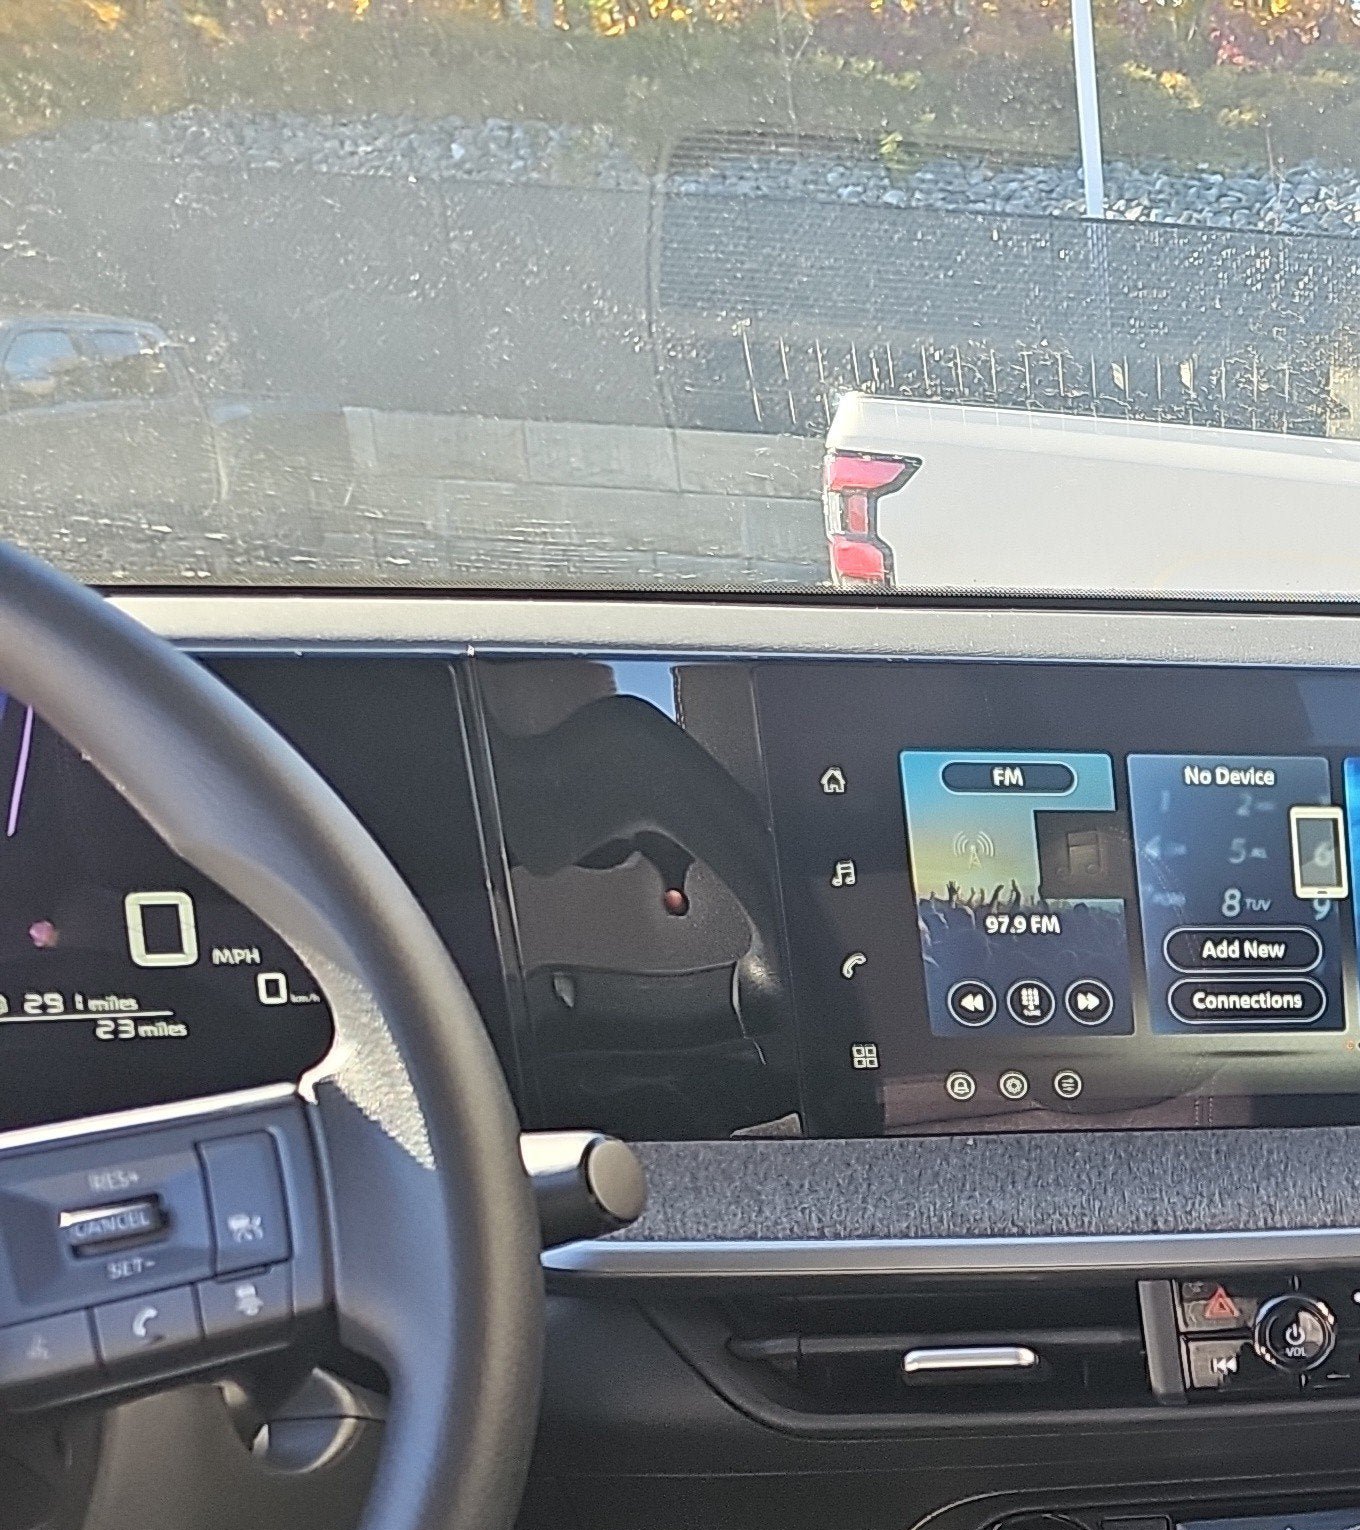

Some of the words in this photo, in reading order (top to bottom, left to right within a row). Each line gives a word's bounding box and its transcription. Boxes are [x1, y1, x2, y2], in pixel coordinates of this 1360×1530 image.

[992, 767, 1024, 787] FM
[1184, 766, 1212, 785] No
[1215, 767, 1275, 785] Device
[124, 891, 199, 967] 0
[985, 915, 1027, 934] 97.9
[1030, 917, 1061, 935] FM
[212, 947, 261, 965] MPH
[1202, 938, 1240, 959] Add
[1243, 939, 1286, 959] New
[257, 972, 288, 1005] 0
[87, 995, 138, 1012] miles
[1192, 991, 1303, 1010] Connections
[95, 1019, 135, 1039] 23
[138, 1021, 188, 1038] miles
[73, 1211, 149, 1238] CANCEL
[1285, 1346, 1306, 1358] VOL
